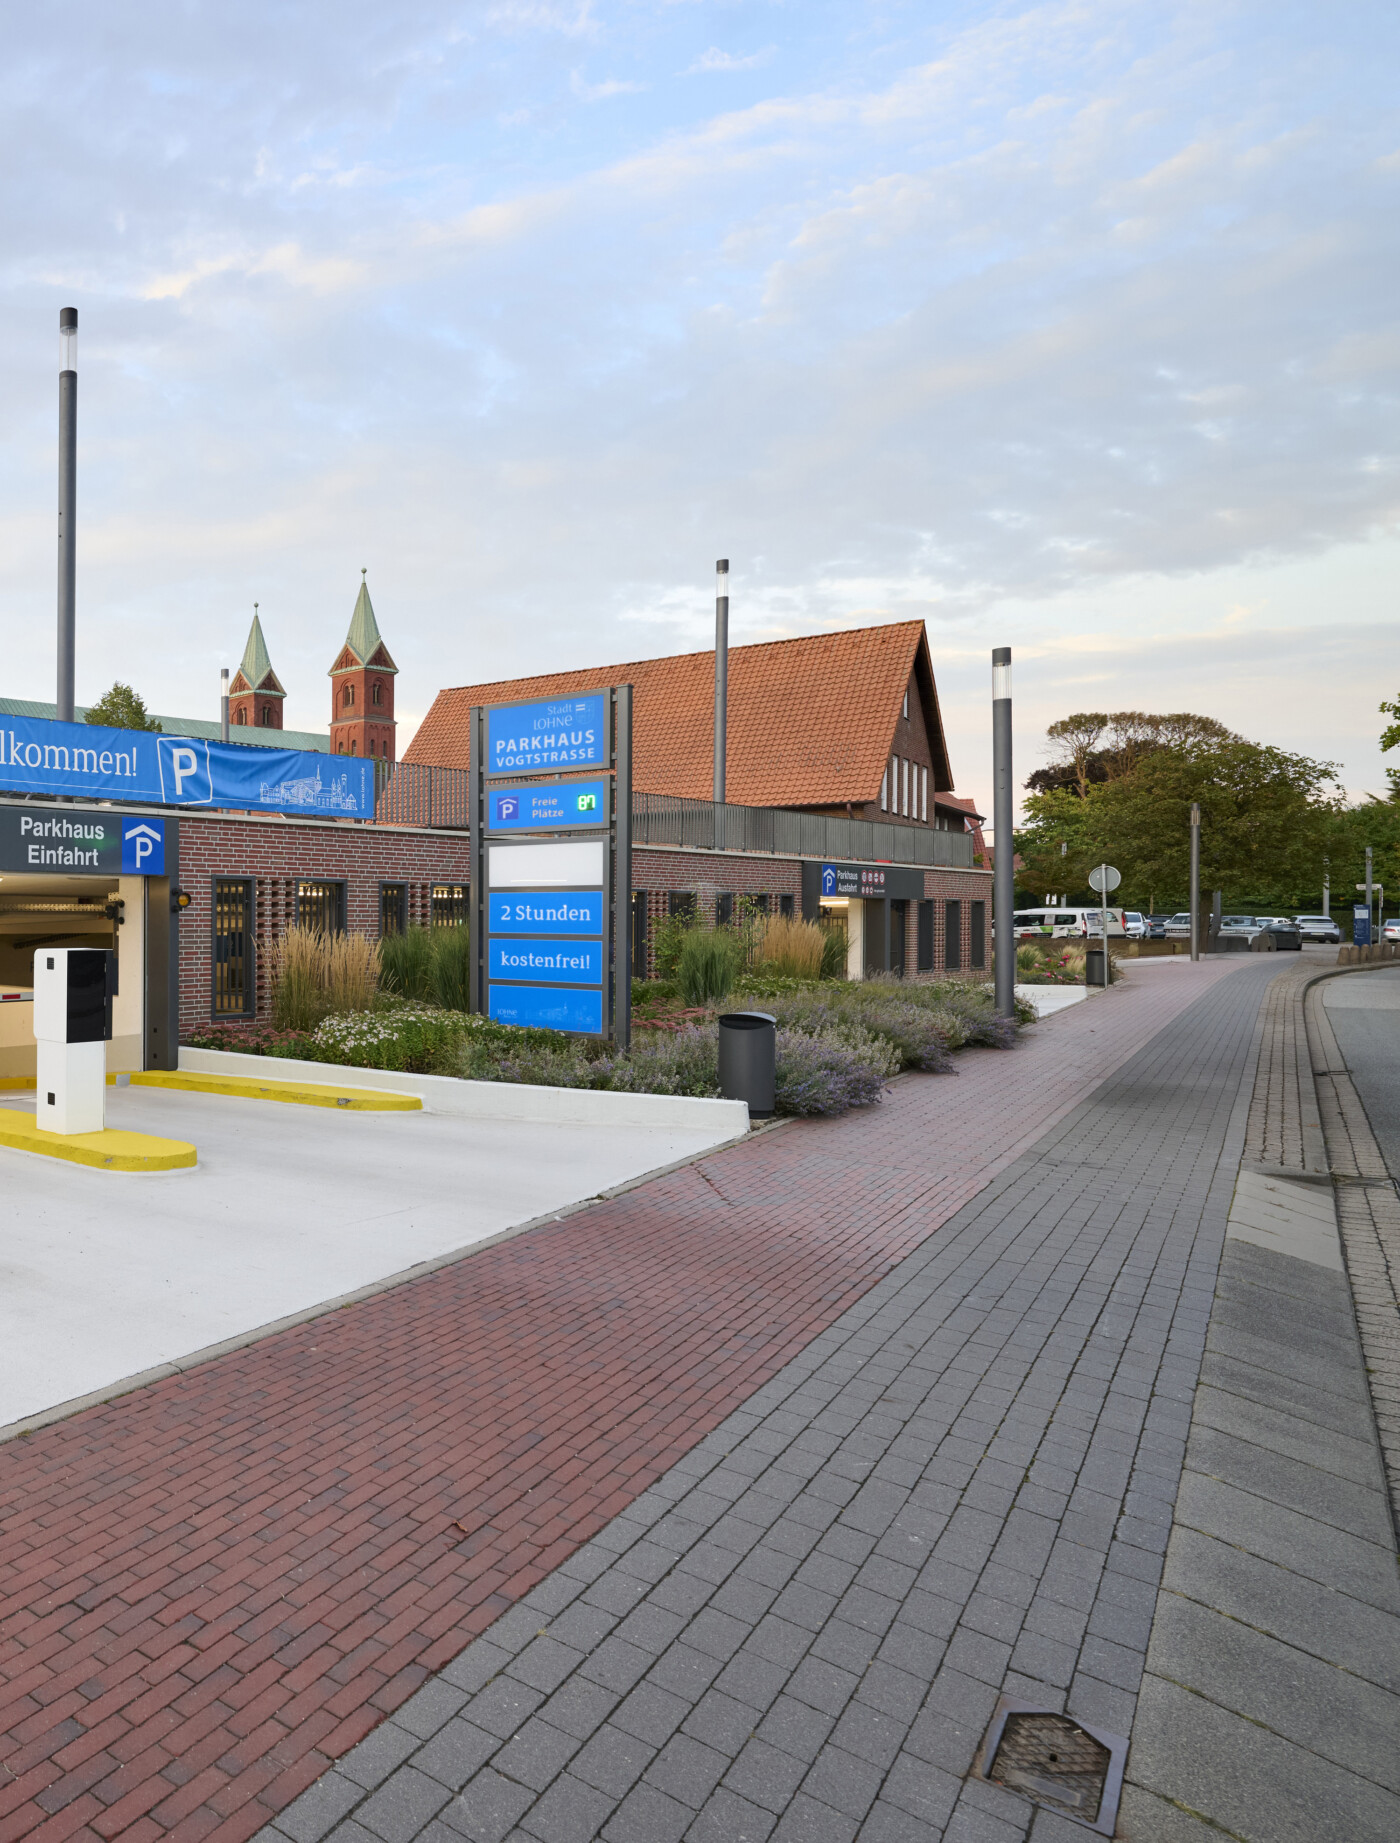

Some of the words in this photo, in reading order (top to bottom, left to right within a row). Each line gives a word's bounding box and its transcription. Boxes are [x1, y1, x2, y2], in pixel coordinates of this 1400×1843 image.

[547, 704, 572, 715] Stadt
[496, 730, 595, 753] PARKHAUS
[496, 748, 595, 767] VOGTSTRASSE
[172, 748, 197, 795] P
[532, 797, 558, 806] Freie
[502, 804, 513, 819] P
[532, 809, 564, 818] Plätze
[21, 816, 104, 839] Parkhaus
[28, 844, 98, 866] Einfahrt
[136, 837, 153, 868] P
[827, 875, 832, 893] P
[837, 870, 858, 880] Parkhaus
[838, 883, 857, 893] Ausfahrt
[501, 905, 511, 920] 2
[515, 904, 591, 921] Stunden
[501, 951, 590, 969] kostenfrei!
